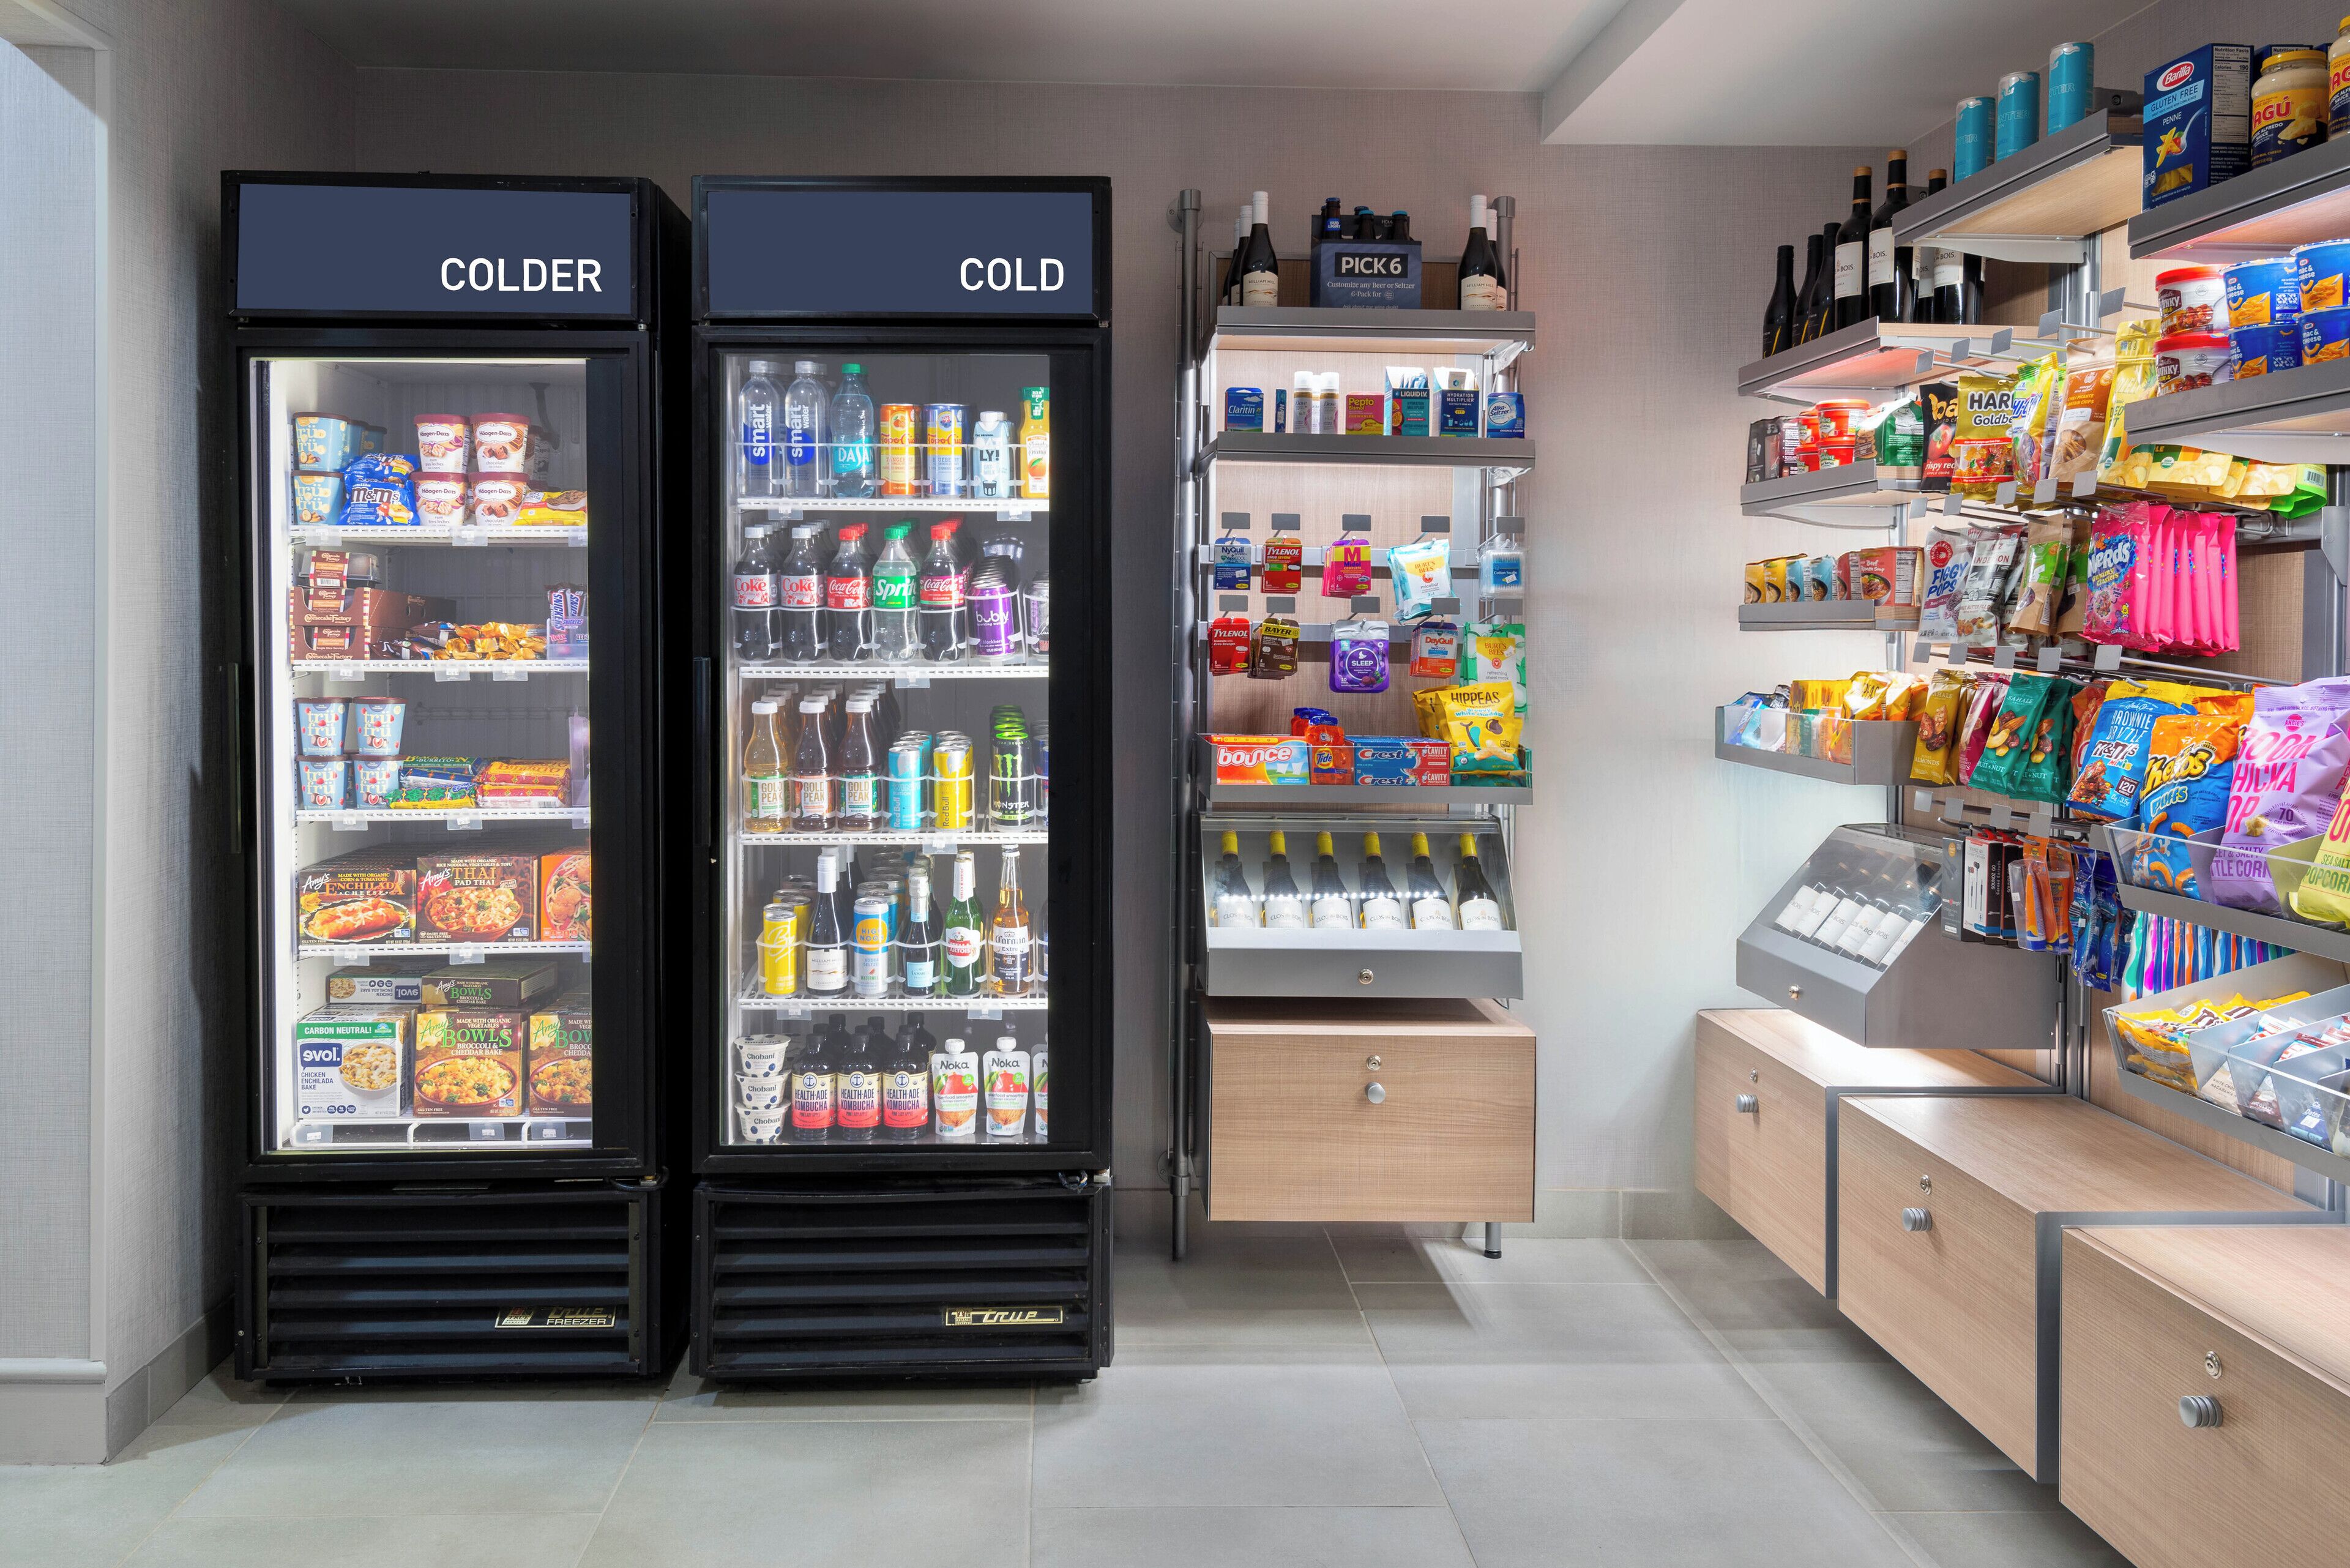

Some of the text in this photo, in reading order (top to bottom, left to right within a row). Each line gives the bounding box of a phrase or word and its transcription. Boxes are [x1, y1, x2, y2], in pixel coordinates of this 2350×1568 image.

[2165, 65, 2191, 85] Barilla
[2151, 84, 2198, 112] GLUTEN FREE
[2335, 93, 2348, 103] SAUCE
[2163, 111, 2182, 125] PENNE
[2253, 96, 2291, 129] AGÚ
[2261, 122, 2283, 133] ALFREDO
[2256, 132, 2268, 141] SAUCE
[1341, 257, 1401, 274] PICK 6
[441, 258, 602, 292] COLDER
[960, 258, 1064, 291] COLD
[1348, 398, 1375, 406] Pepto
[1228, 405, 1255, 414] Claritin
[1973, 414, 2013, 425] Goldbe
[750, 404, 765, 457] smart
[791, 404, 803, 458] smart
[980, 449, 999, 461] LY!
[1344, 547, 1361, 561] M
[1932, 562, 1968, 583] FIGGY
[734, 578, 766, 592] Coke
[783, 578, 815, 592] Coke
[829, 580, 865, 594] Coca-Cola
[1927, 580, 1957, 597] POPS
[553, 592, 565, 632] SNICKERS
[1425, 637, 1453, 646] DayQuil
[1451, 692, 1500, 704] HIPPEAS
[2007, 695, 2033, 704] SAHALE
[2111, 711, 2153, 730] BROWNIE
[1218, 746, 1292, 767] bounce
[1316, 753, 1332, 764] Tide
[1359, 749, 1403, 759] Crest
[1358, 775, 1403, 785] Crest
[2231, 762, 2297, 793] HICKA
[761, 782, 782, 793] GOLD
[804, 782, 824, 792] GOLD
[848, 782, 869, 791] GOLD
[2119, 780, 2135, 794] 120
[761, 793, 783, 802] PEAK
[804, 793, 824, 802] PEAK
[848, 792, 869, 802] PEAK
[2150, 786, 2188, 818] PUFFS
[2279, 807, 2294, 822] 70
[419, 868, 453, 891] Amy's
[452, 867, 496, 879] THAI
[302, 873, 331, 893] Amy's
[324, 881, 405, 897] ENCHILADA
[436, 980, 457, 994] Amy's
[450, 988, 492, 999] BOWLS
[420, 1017, 454, 1042] Amy's
[441, 1028, 512, 1048] BOWLS
[940, 1061, 969, 1070] Noka
[991, 1058, 1020, 1067] Noka
[795, 1100, 827, 1111] KOMBUCHA
[841, 1100, 874, 1110] KOMBUCHA
[886, 1100, 919, 1110] KOMBUCHA
[2304, 1108, 2321, 1118] Dates
